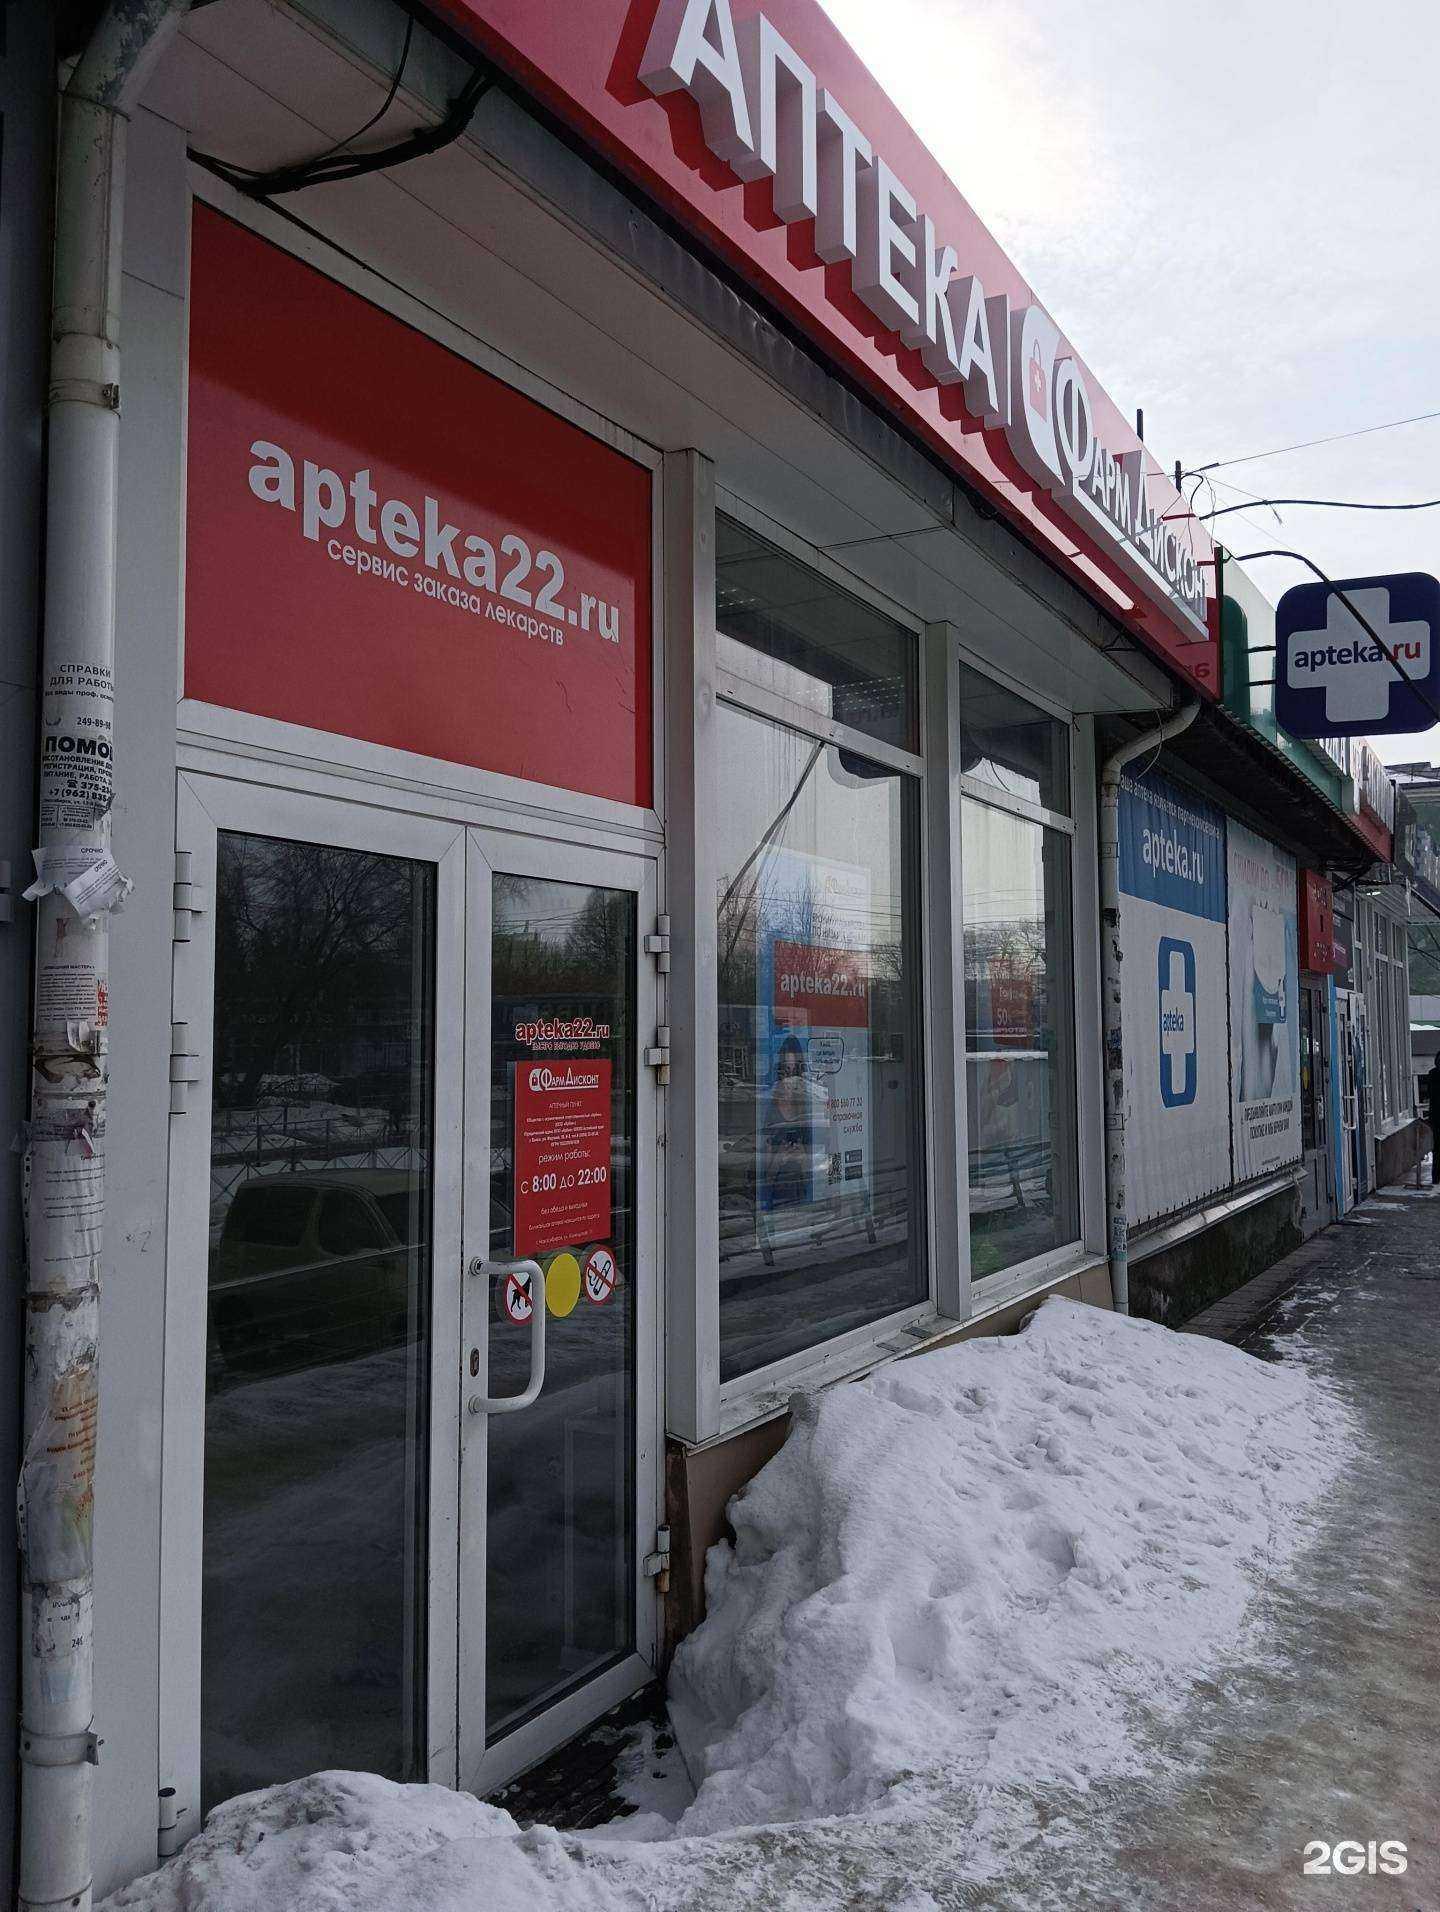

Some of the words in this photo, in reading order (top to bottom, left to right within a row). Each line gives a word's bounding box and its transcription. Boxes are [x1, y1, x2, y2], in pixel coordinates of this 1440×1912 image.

[660, 0, 999, 414] АПТЕКА
[248, 439, 620, 643] apteka22.ru
[327, 538, 409, 587] сервис
[413, 572, 481, 615] заказа
[485, 600, 565, 646] лекарств
[49, 676, 73, 687] ДЛЯ
[60, 664, 111, 678] СПРАВКИ
[61, 788, 90, 800] (962)
[1143, 828, 1204, 885] apteka.ru
[781, 972, 865, 998] apteka22.ru
[515, 1017, 610, 1046] apteka22.ru
[1163, 1007, 1184, 1037] apteka
[538, 1153, 563, 1165] режим
[532, 1173, 557, 1193] 8:00
[577, 1166, 607, 1186] 22:00
